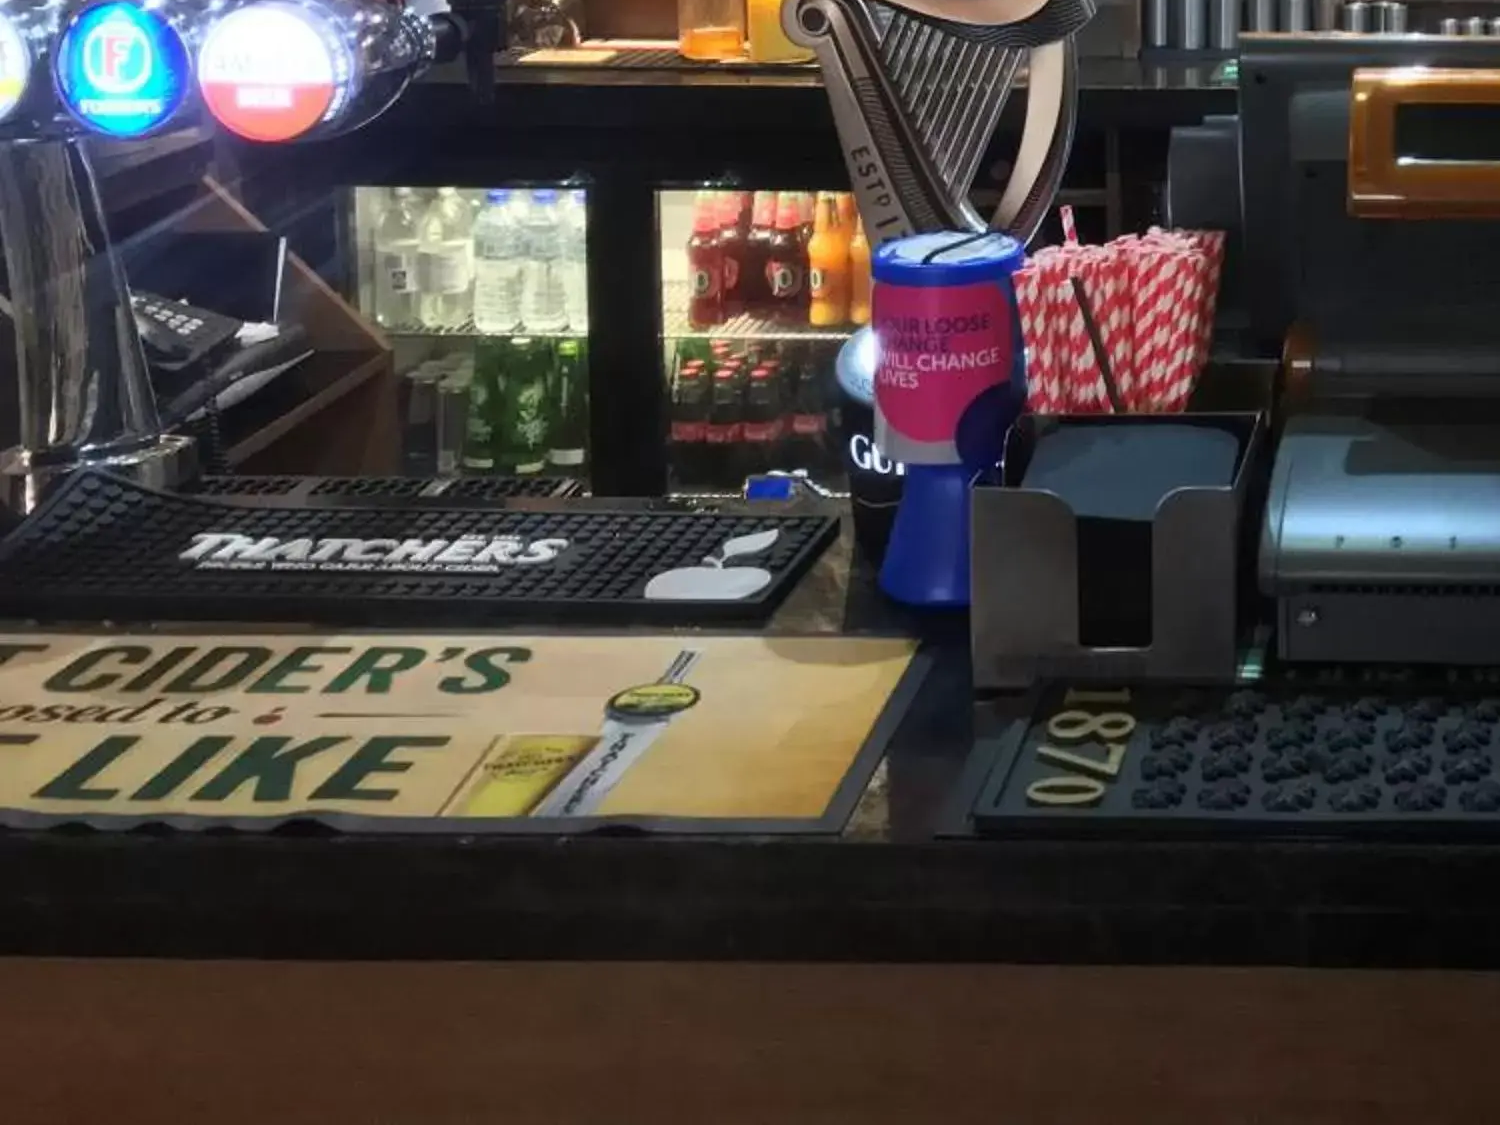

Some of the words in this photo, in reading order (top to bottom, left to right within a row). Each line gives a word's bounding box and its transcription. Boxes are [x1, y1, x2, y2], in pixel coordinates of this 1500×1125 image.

[925, 311, 993, 335] LOOSE
[880, 349, 913, 372] WILL
[916, 347, 1001, 373] CHANGE
[878, 366, 919, 389] LIVES
[178, 532, 569, 565] THATCHERS
[43, 645, 533, 695] CIDER'S
[157, 698, 238, 725] to
[30, 734, 452, 802] LIKE
